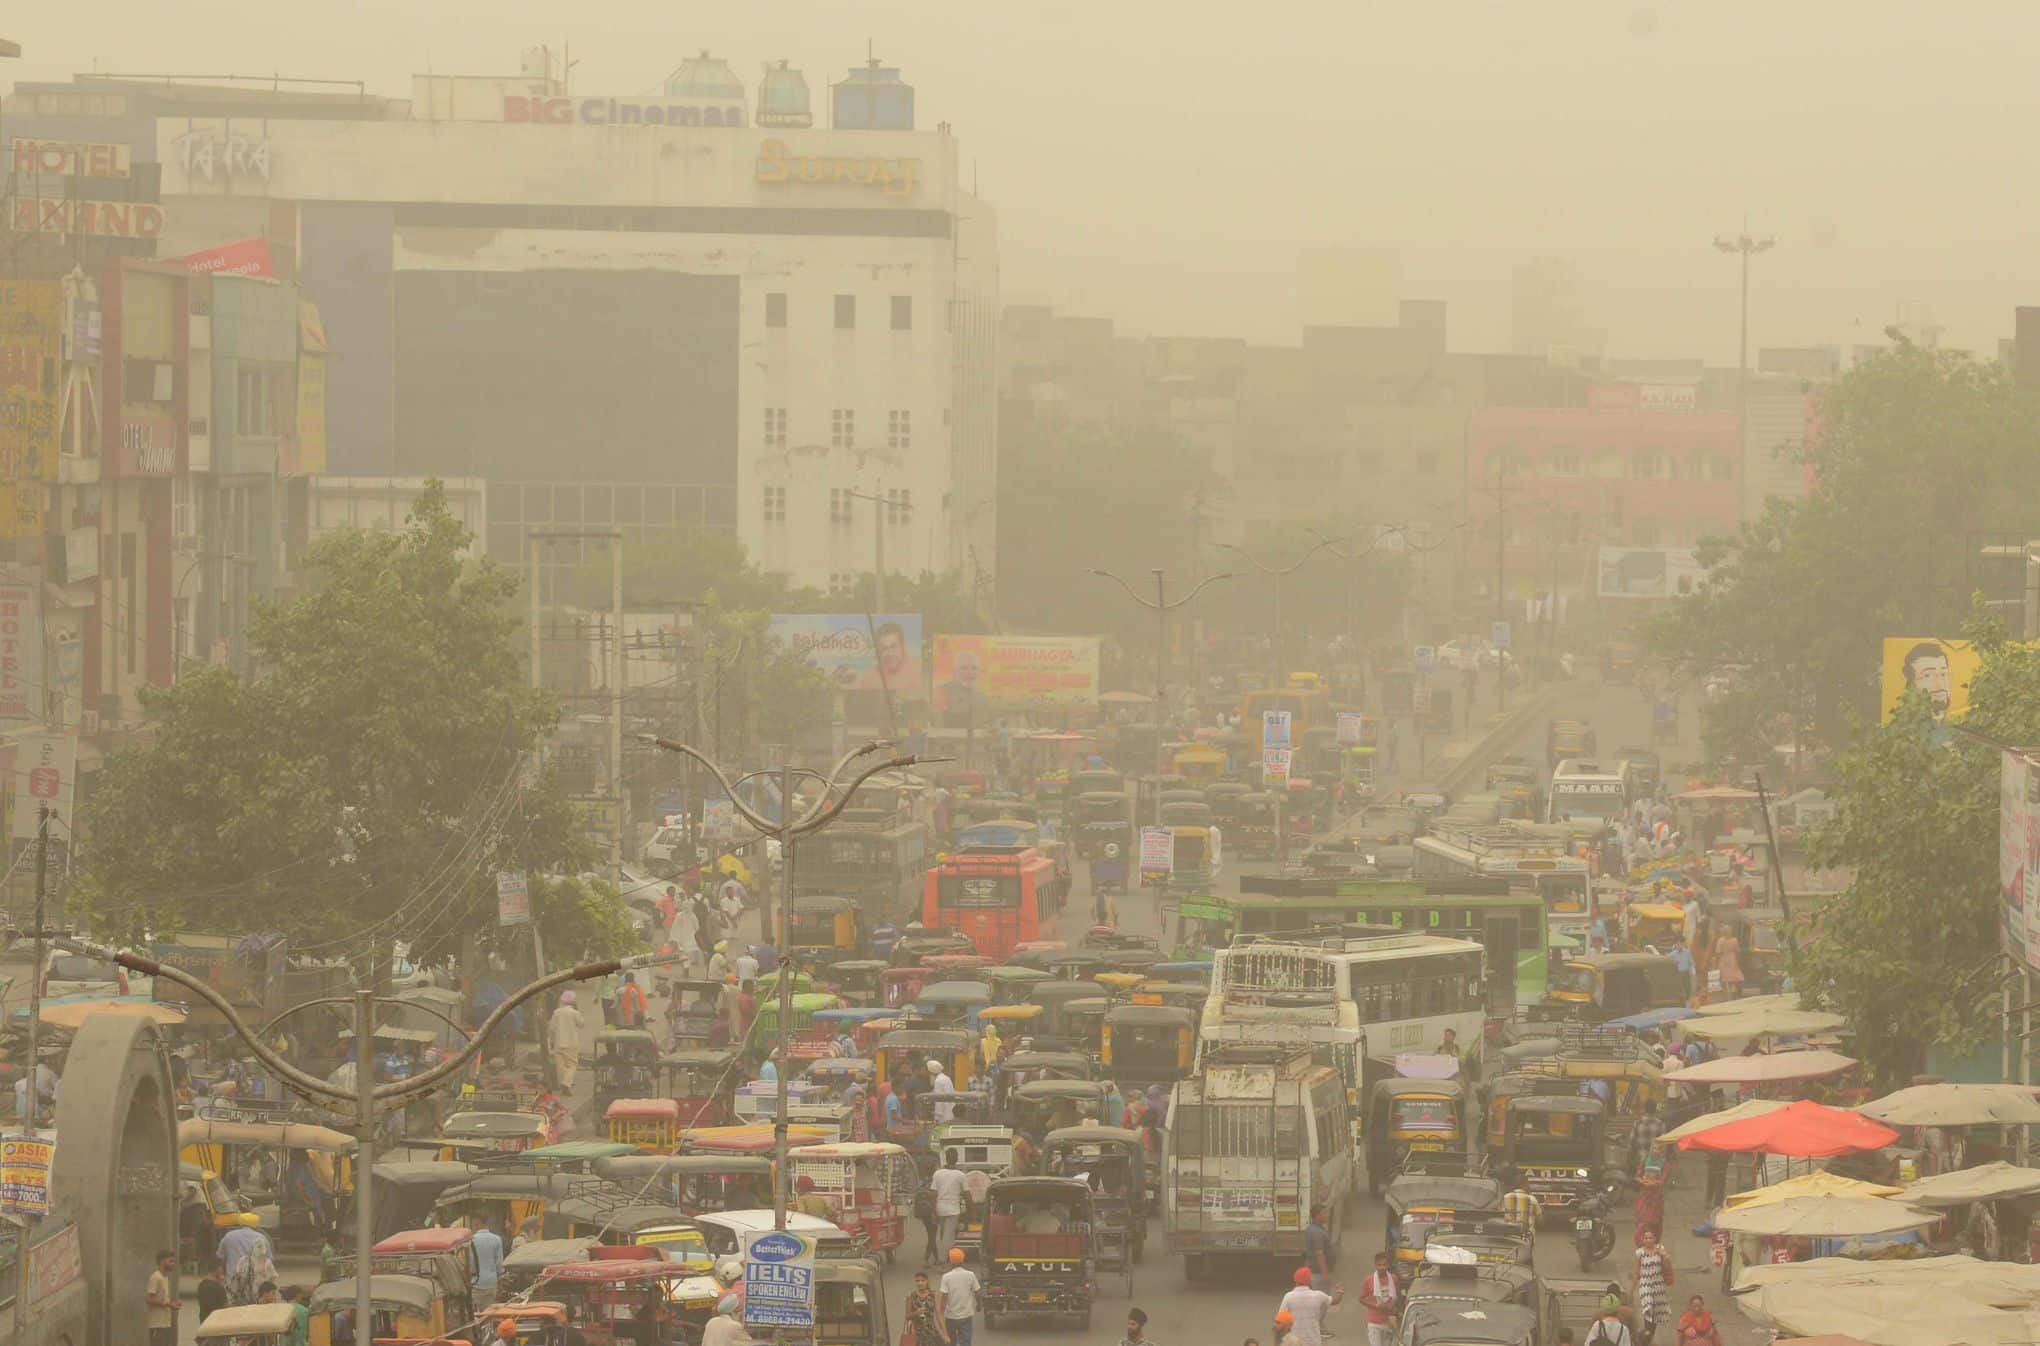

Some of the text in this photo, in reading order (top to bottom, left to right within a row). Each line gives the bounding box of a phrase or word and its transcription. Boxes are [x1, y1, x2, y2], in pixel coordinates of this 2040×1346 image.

[504, 96, 742, 127] BIG Cinemas
[750, 1264, 806, 1285] IELTS
[1004, 1261, 1073, 1273] ATUL
[747, 1283, 778, 1297] SPOKEN
